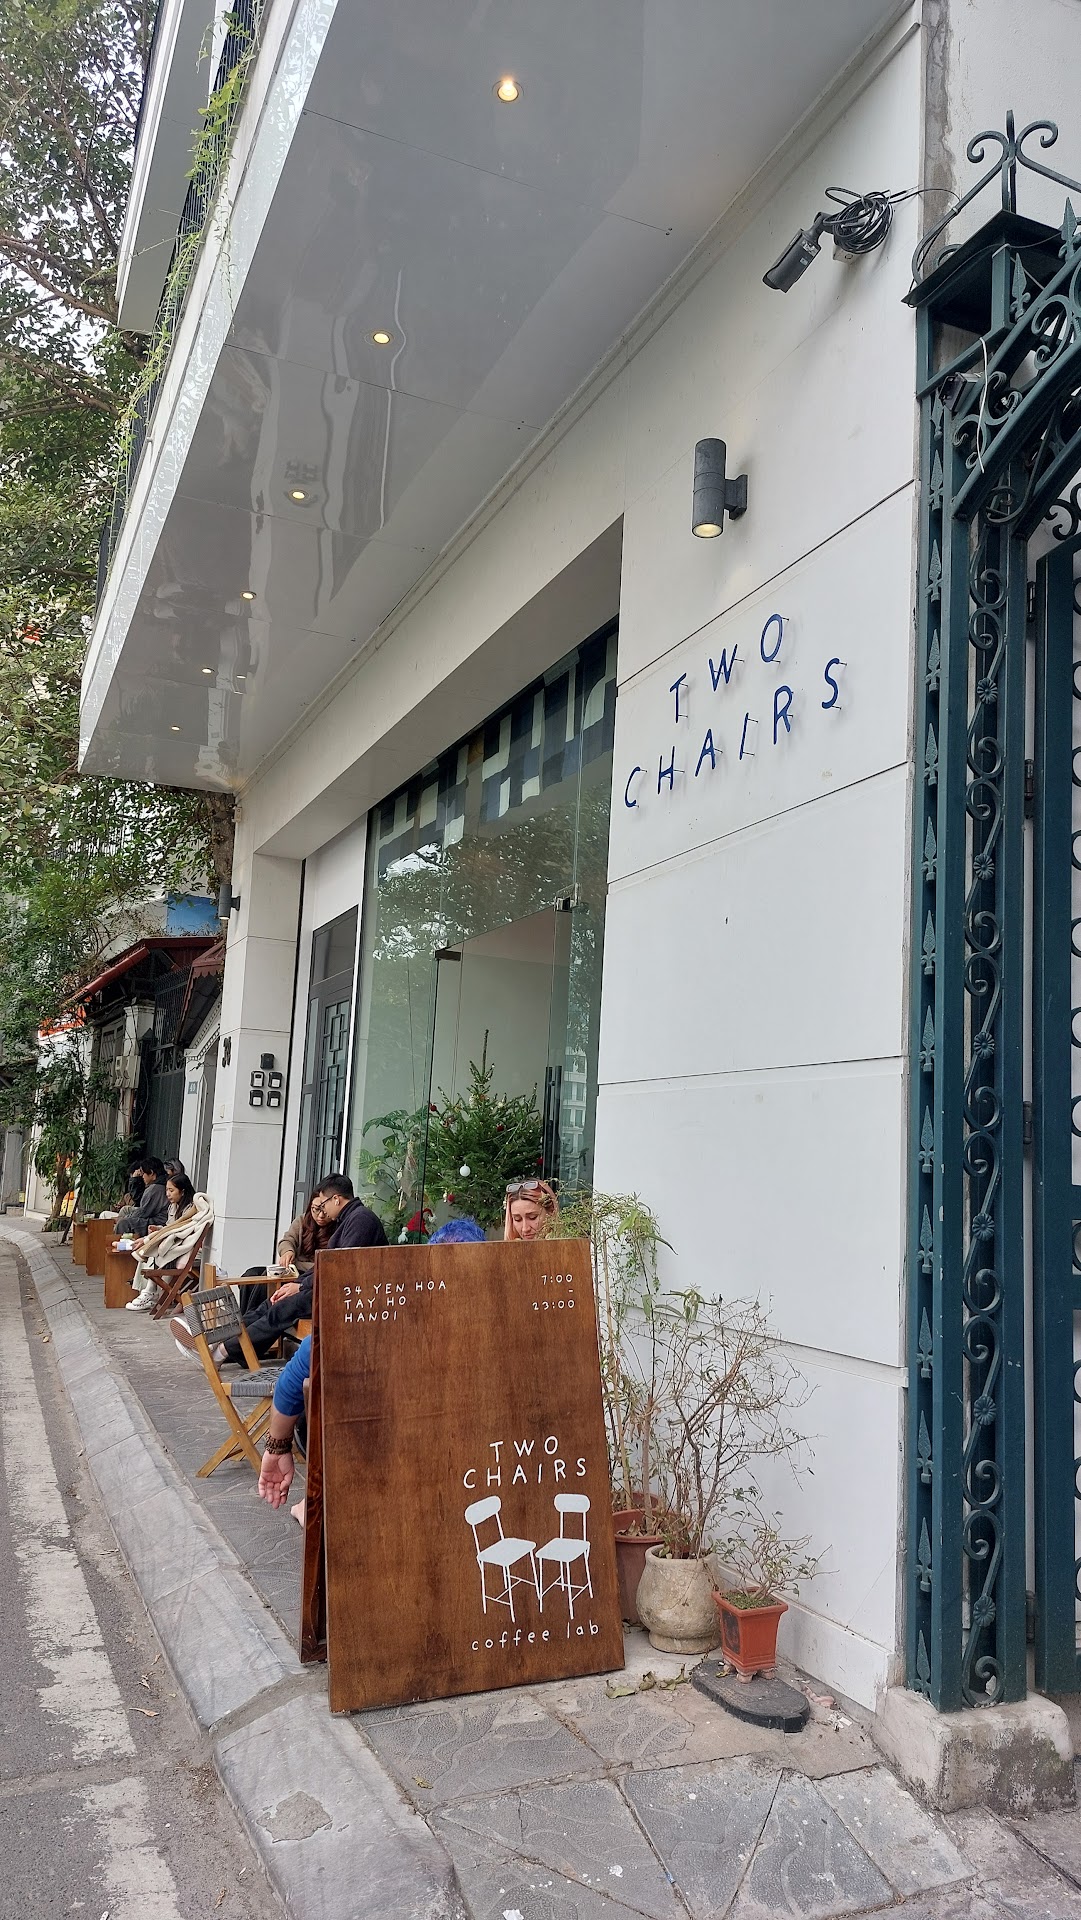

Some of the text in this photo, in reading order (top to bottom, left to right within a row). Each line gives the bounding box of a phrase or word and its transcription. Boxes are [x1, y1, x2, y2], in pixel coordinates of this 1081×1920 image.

[669, 612, 784, 724] TWO
[623, 656, 841, 809] CHAIRS
[343, 1279, 447, 1297] 34 YEN HOA
[541, 1273, 574, 1286] 7:00
[344, 1292, 407, 1310] TAY HO
[531, 1299, 576, 1311] 23:00
[343, 1309, 398, 1324] HANOI
[489, 1435, 559, 1463] TWO
[463, 1457, 587, 1489] CHAIRS
[471, 1620, 599, 1651] coffee lab
